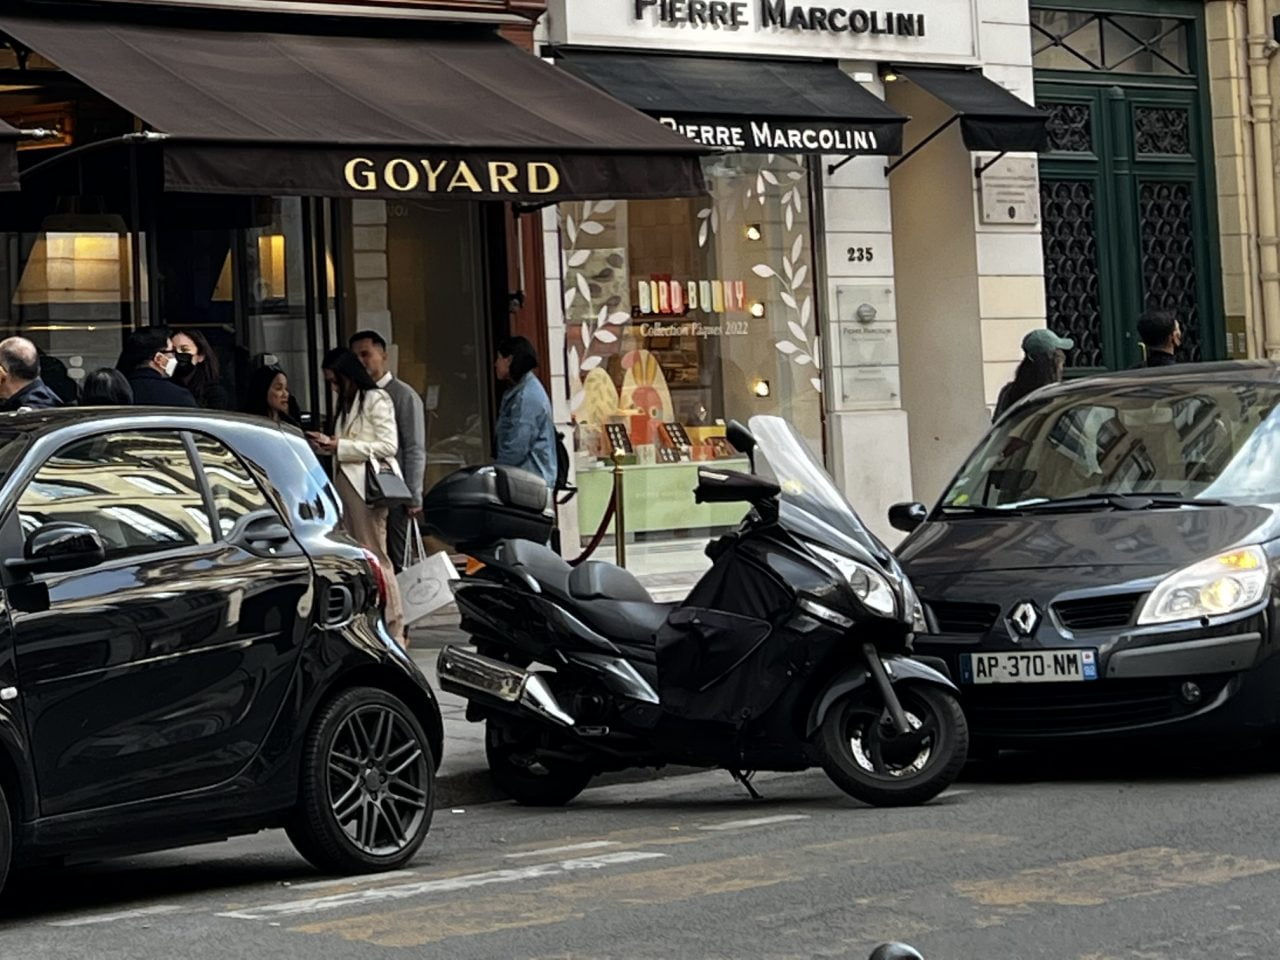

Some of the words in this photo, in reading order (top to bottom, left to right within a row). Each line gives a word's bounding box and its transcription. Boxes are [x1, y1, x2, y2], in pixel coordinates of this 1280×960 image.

[751, 121, 878, 150] MARCOLINI
[344, 157, 560, 194] GOYARD
[847, 247, 874, 262] 235
[725, 321, 749, 335] 2022
[976, 653, 1080, 678] AP-370-NM
